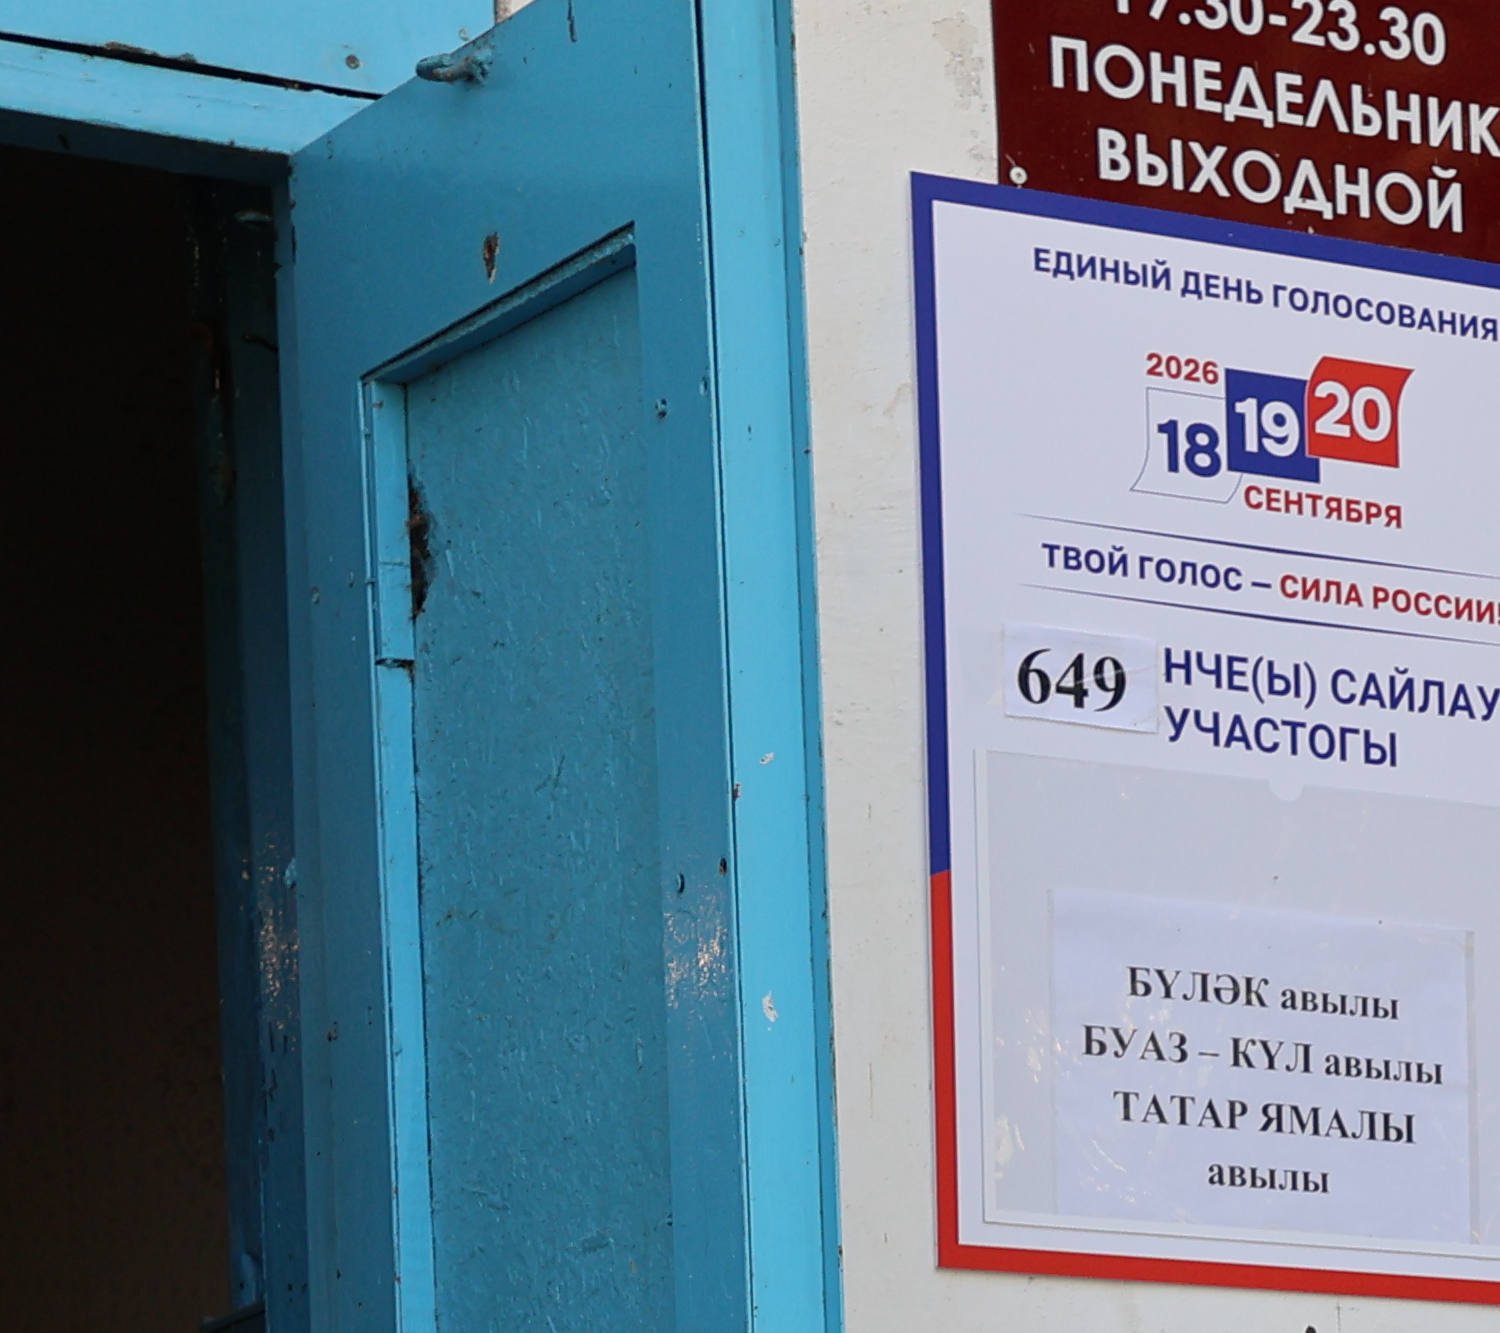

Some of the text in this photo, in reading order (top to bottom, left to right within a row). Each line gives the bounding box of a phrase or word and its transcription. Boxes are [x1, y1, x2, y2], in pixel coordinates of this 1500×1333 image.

[1115, 0, 1445, 66] .30-23.30
[1096, 127, 1462, 234] ВЫХОДНОЙ
[1035, 248, 1500, 341] ЕДИНЫЙ ДЕНЬ ГОЛОСОВАНИЯ
[1147, 353, 1218, 384] 2026
[1158, 379, 1391, 477] 18 19 20
[1245, 484, 1401, 528] СЕНТЯБРЯ
[1042, 544, 1127, 576] ТВОЙ
[1140, 556, 1241, 591] ГОЛОС
[1281, 575, 1363, 607] СИЛА
[1018, 648, 1500, 721] 649 НЧЕ(Ы) САЙЛАУ
[1165, 704, 1399, 767] УЧАСТОГЫ
[1130, 967, 1397, 1019] БҮЛӘК авылы
[1085, 1026, 1187, 1063] БУАЗ
[1233, 1038, 1310, 1073] КҮЛ
[1325, 1055, 1441, 1084] авылы
[1114, 1092, 1413, 1143] ТАТАР ЯМАЛЫ
[1209, 1165, 1327, 1193] авылы
